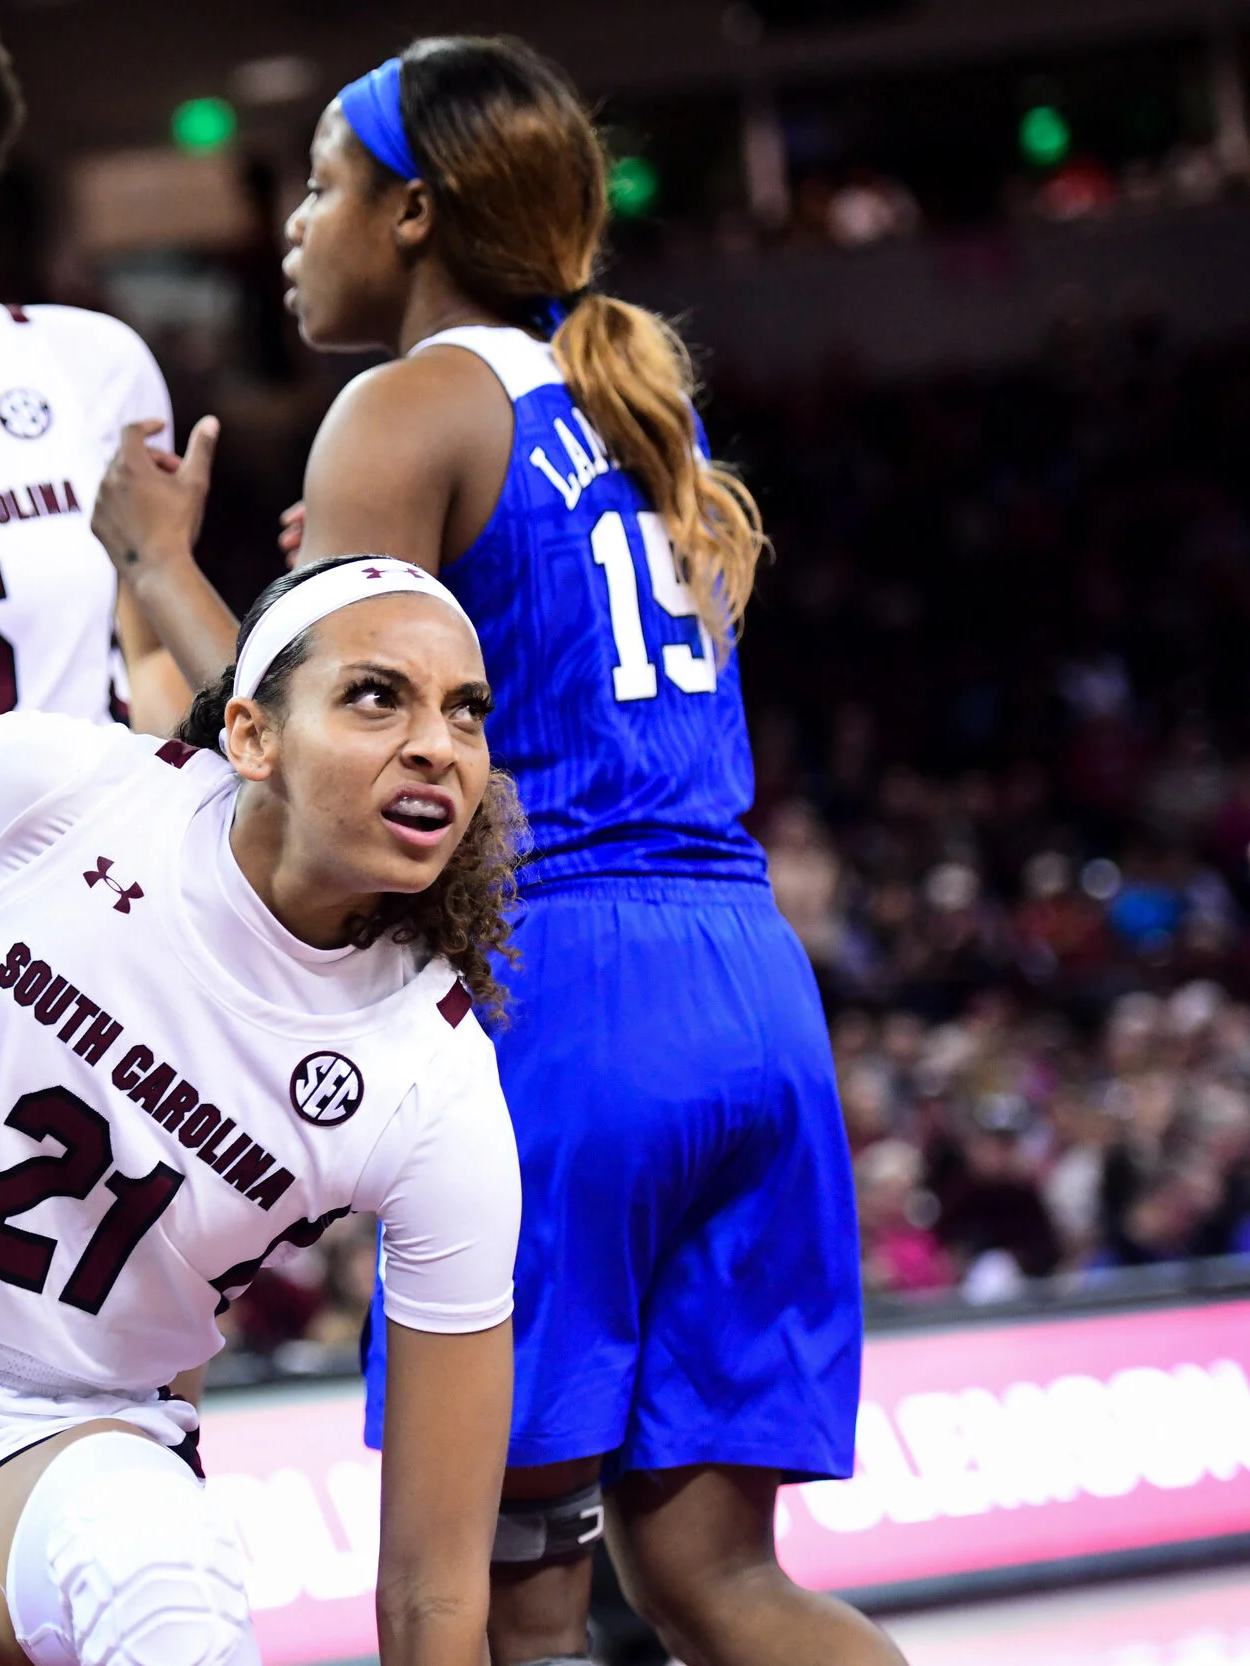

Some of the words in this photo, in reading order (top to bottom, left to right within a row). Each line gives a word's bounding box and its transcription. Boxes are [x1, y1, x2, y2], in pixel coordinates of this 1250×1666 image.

[590, 510, 718, 702] 15
[111, 1044, 296, 1212] CAROLINA
[295, 1055, 359, 1121] SEC
